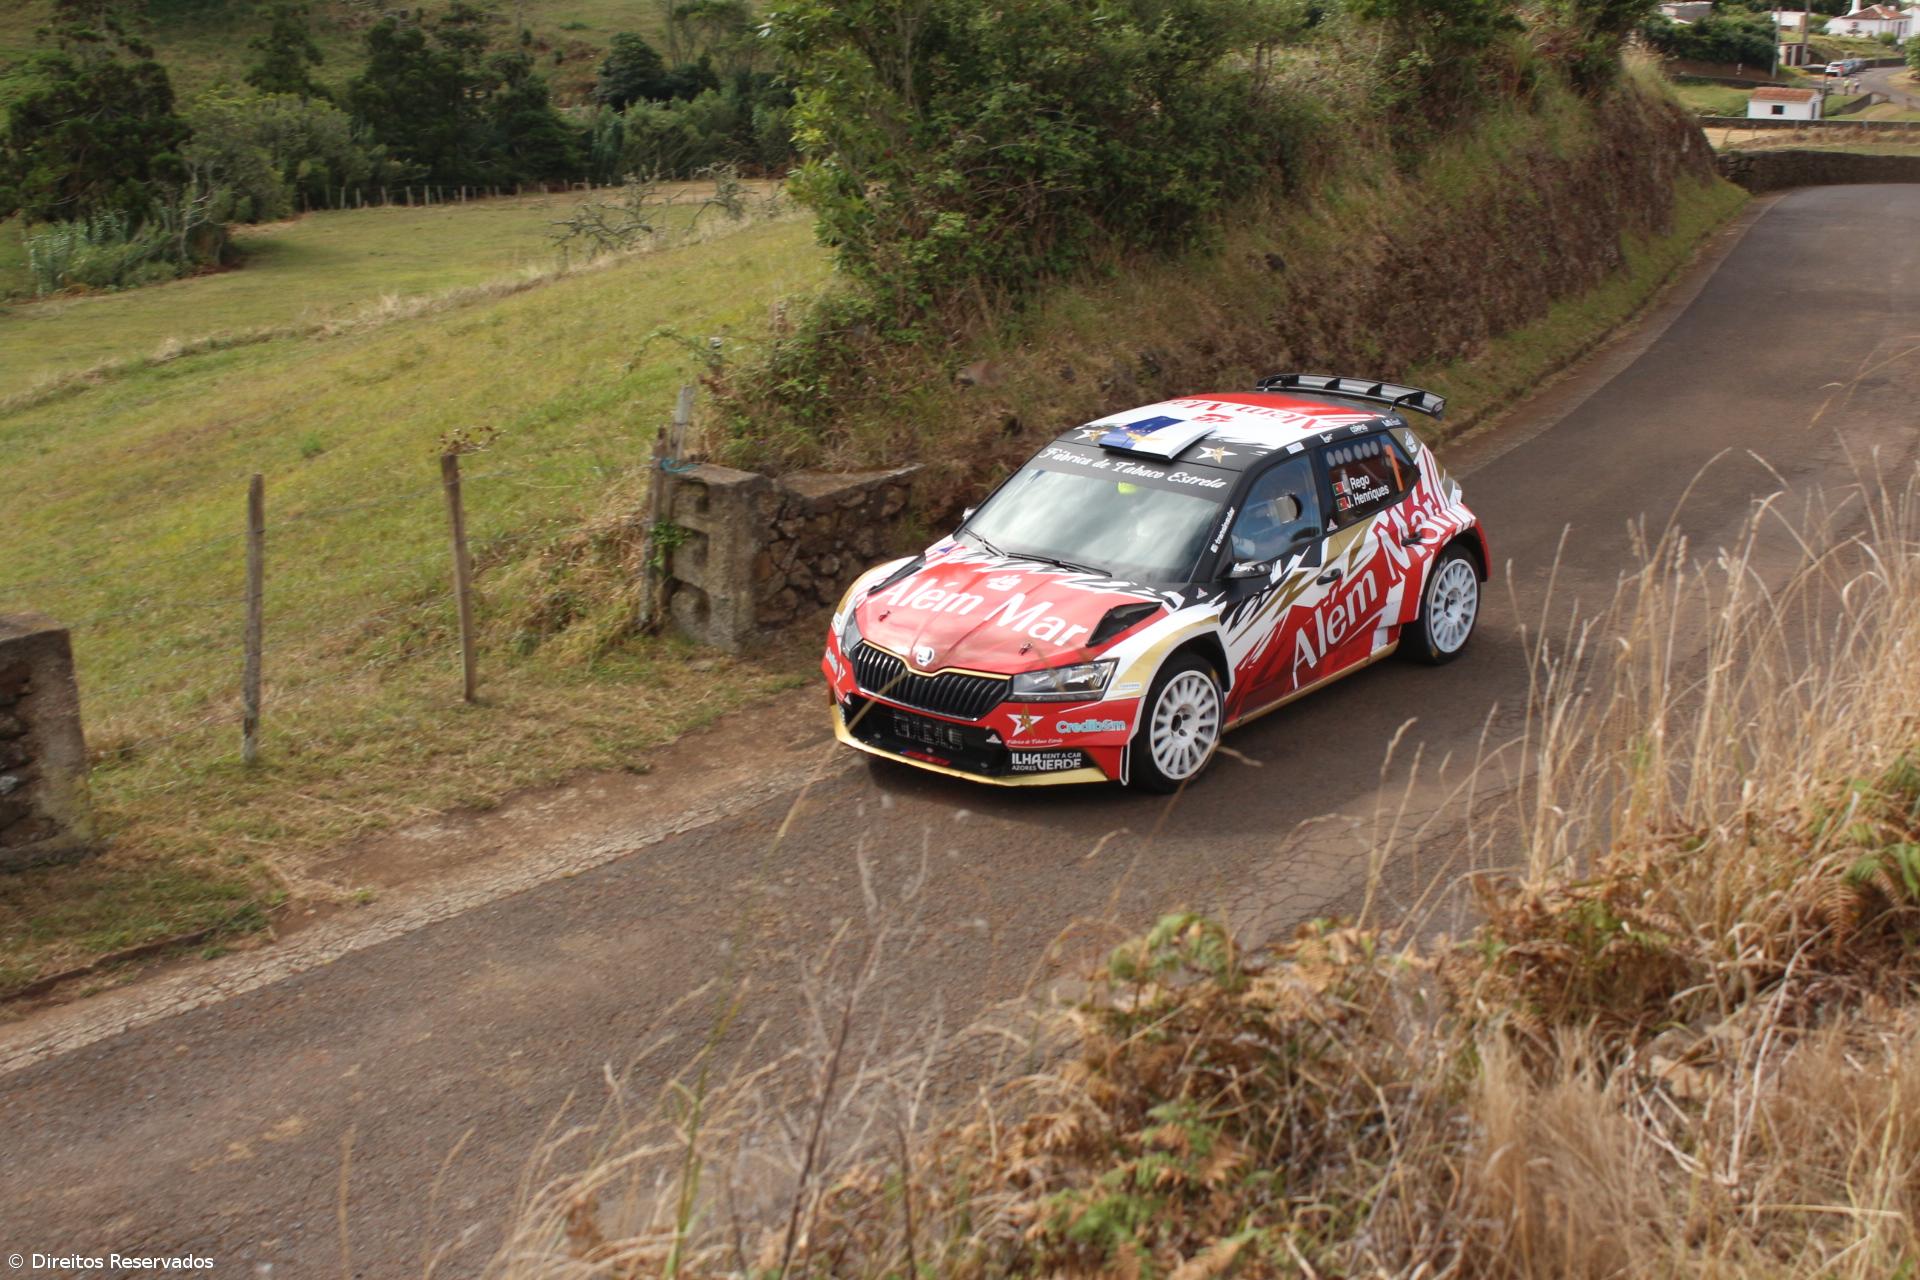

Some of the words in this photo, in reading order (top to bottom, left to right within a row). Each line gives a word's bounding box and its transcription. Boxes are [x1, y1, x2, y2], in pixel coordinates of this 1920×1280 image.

[1038, 447, 1093, 467] Fábrica
[1092, 458, 1109, 469] de
[1111, 461, 1165, 479] Tabaco
[1167, 471, 1227, 489] Estrela
[1350, 475, 1370, 490] Rego
[1346, 496, 1354, 508] J.
[1353, 485, 1390, 506] Henriques
[868, 576, 985, 615] Além
[983, 592, 1088, 646] Mar
[1293, 569, 1377, 690] Além
[1011, 753, 1041, 765] ILHA
[1037, 758, 1082, 770] VERDE
